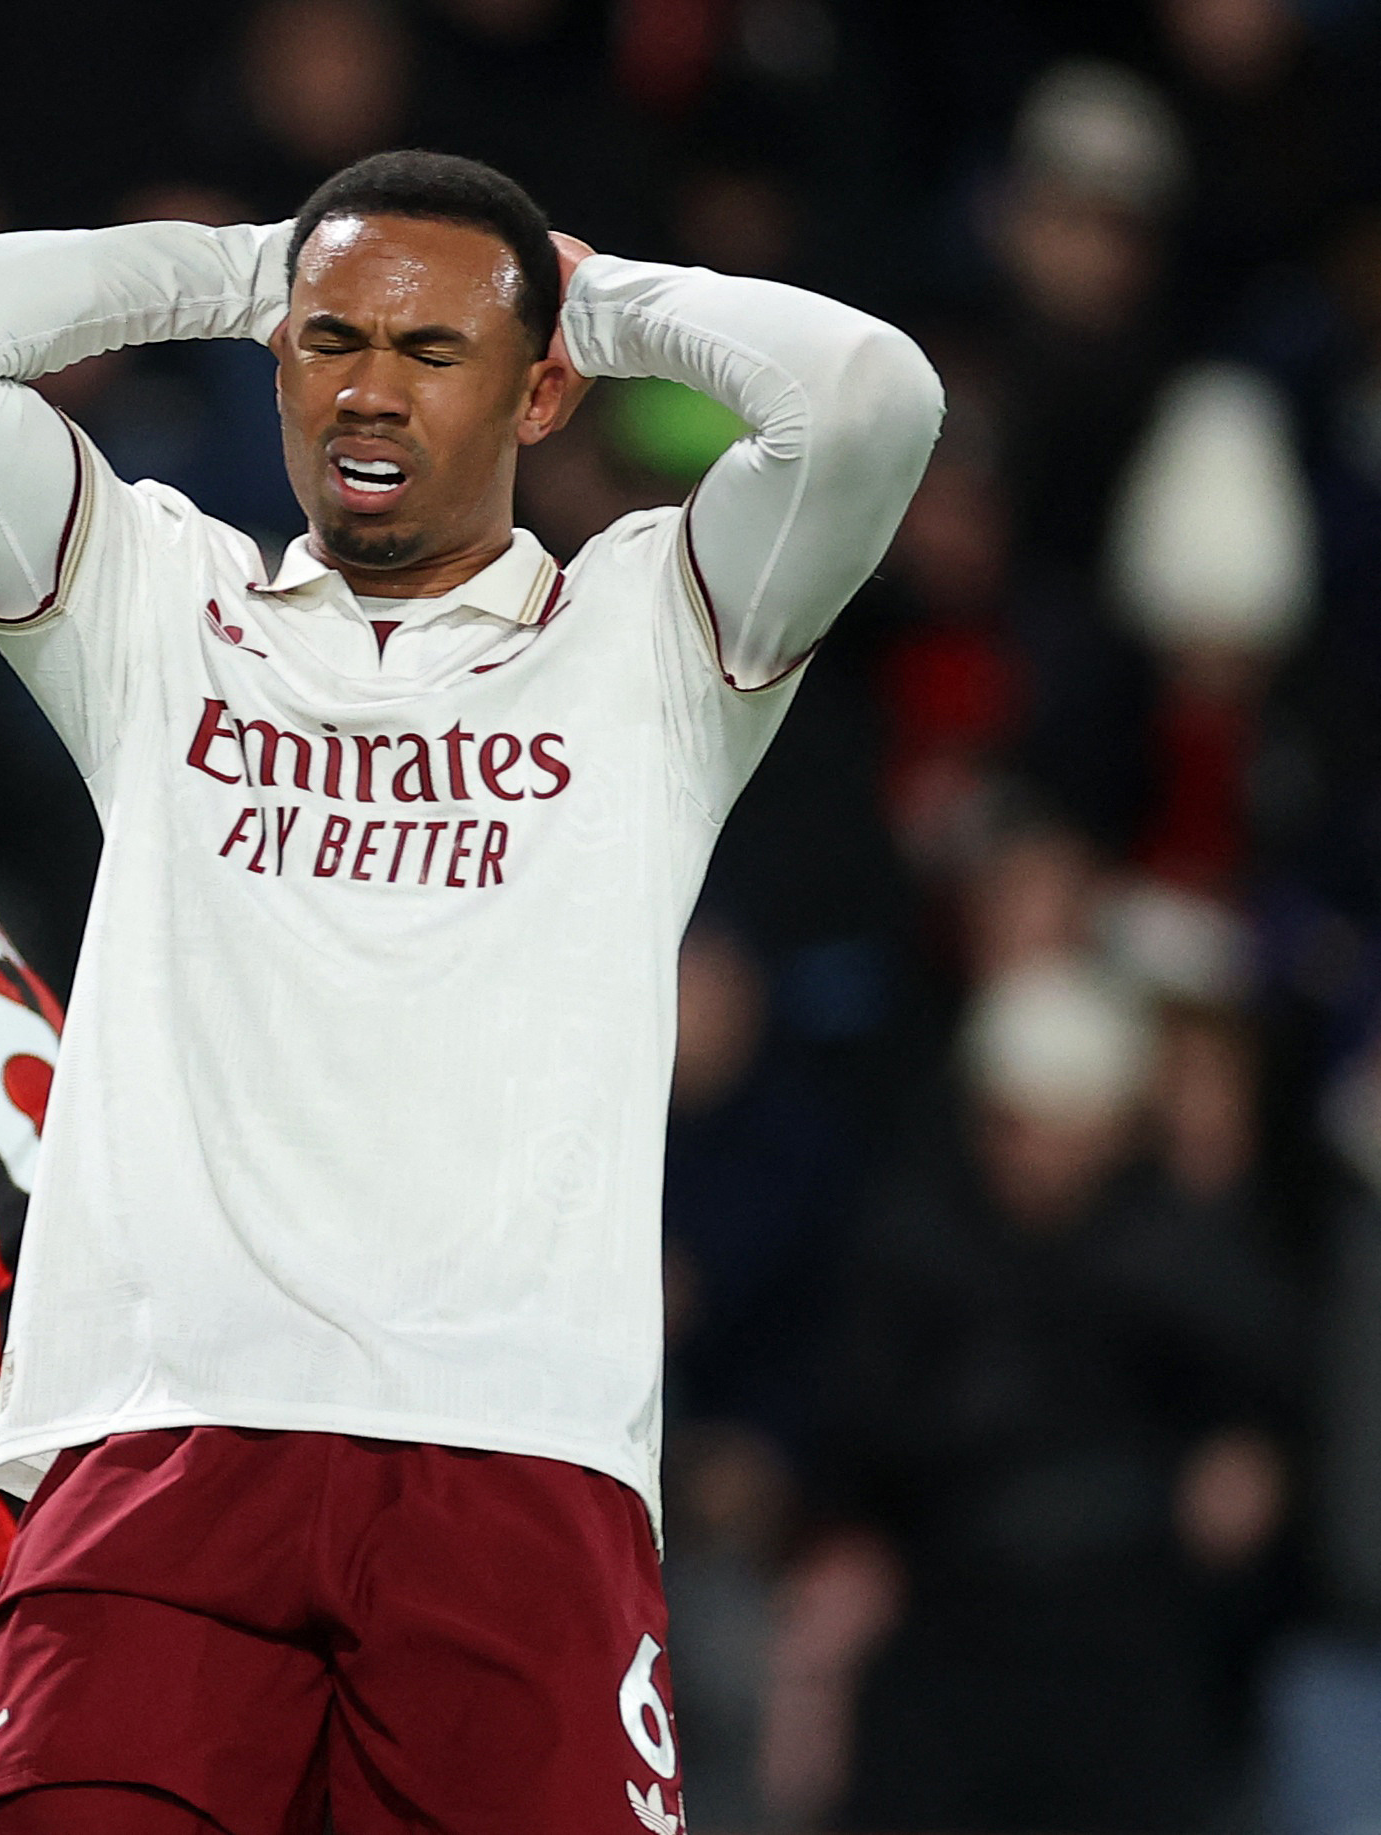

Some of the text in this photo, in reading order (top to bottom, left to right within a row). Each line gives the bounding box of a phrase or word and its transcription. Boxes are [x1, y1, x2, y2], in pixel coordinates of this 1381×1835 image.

[186, 697, 571, 802] Emirates
[218, 806, 509, 888] FLY BETTER
[618, 1632, 677, 1779] 6
